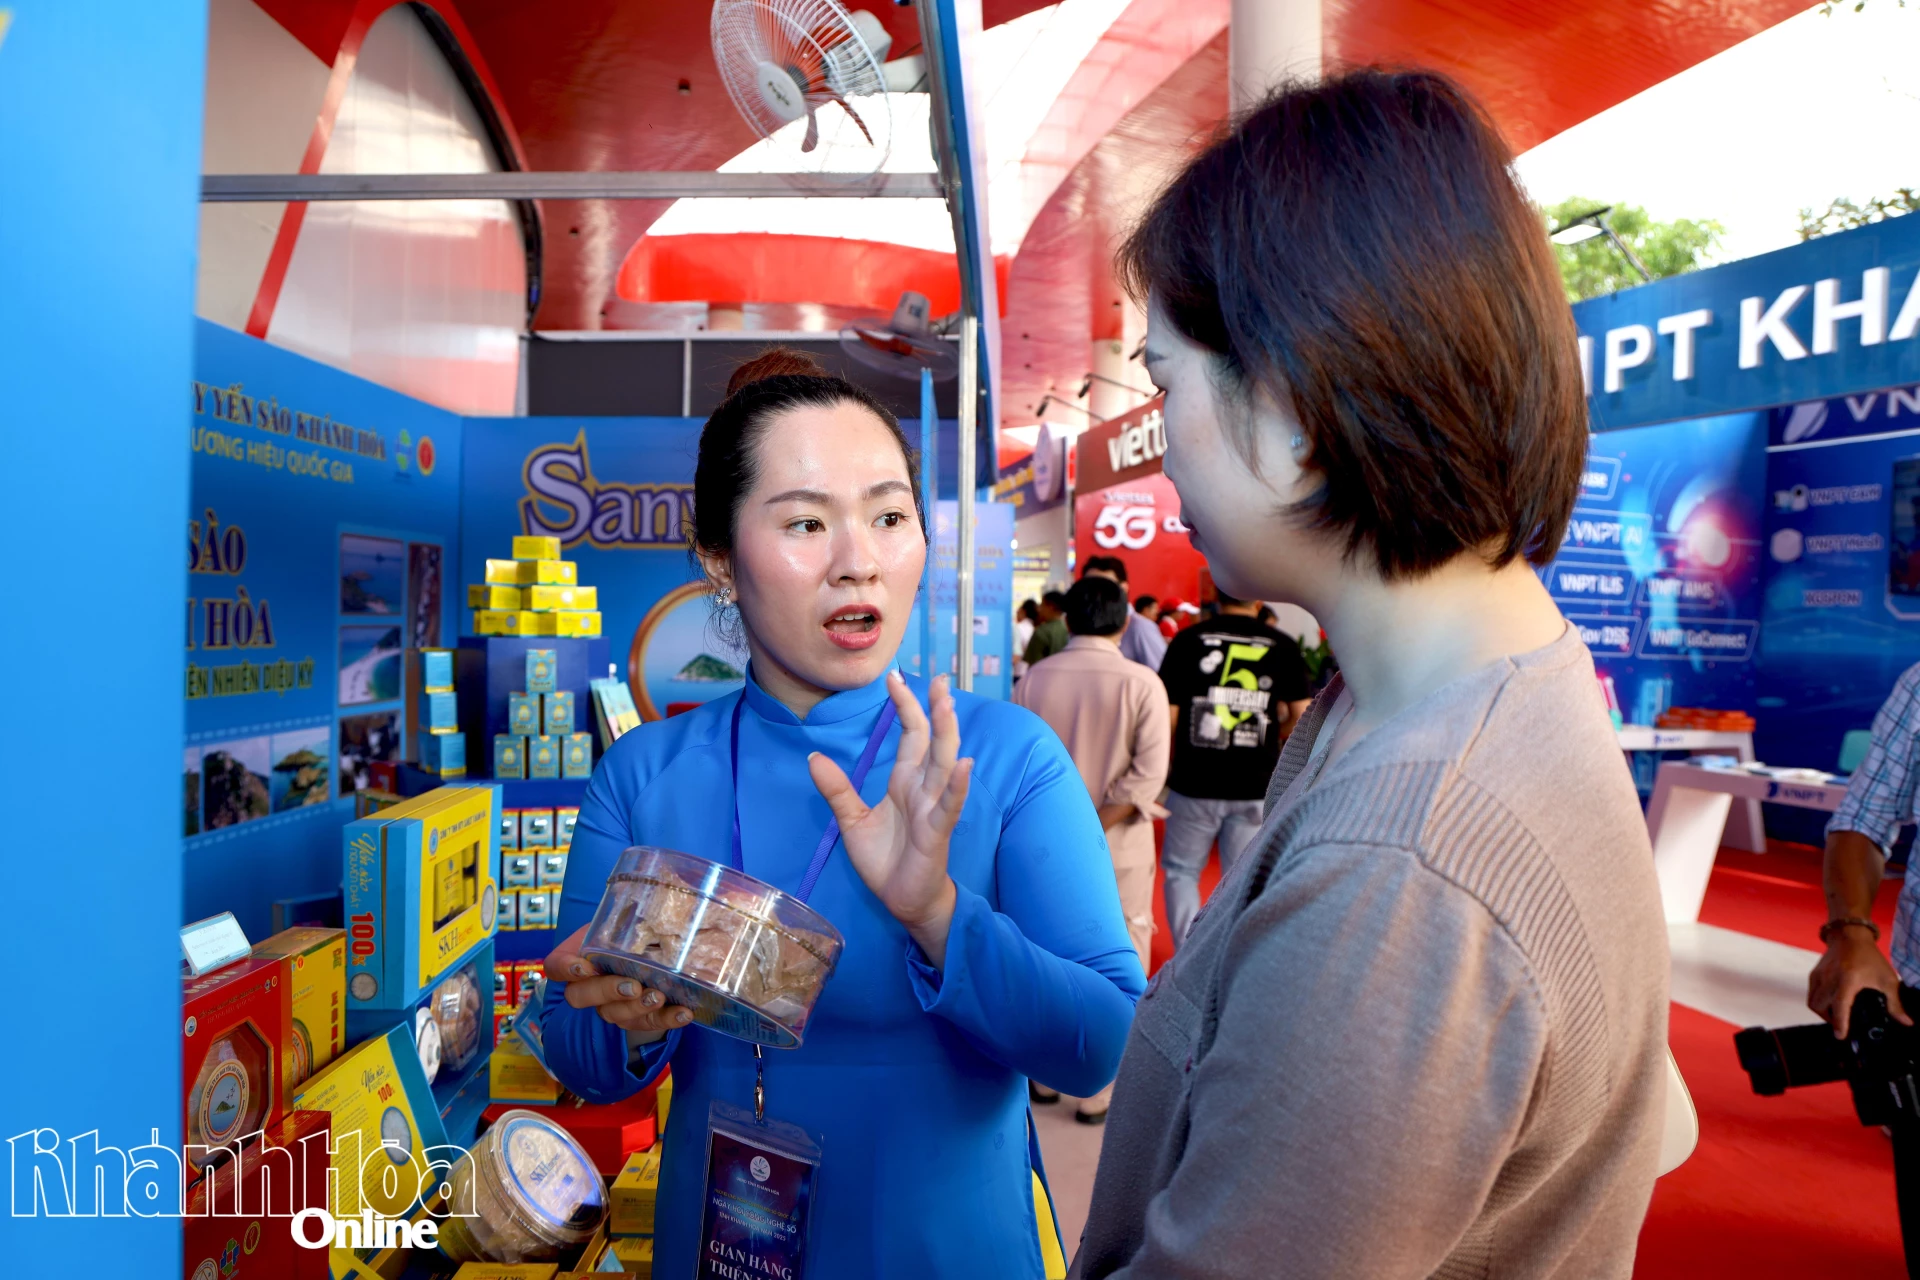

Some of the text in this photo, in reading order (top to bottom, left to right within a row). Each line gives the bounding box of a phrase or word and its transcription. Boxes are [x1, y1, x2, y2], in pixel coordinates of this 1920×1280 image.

[212, 382, 254, 427] YẾN
[257, 395, 292, 437] SÀO
[295, 411, 354, 453] KHÁNH
[357, 428, 387, 461] HÒA
[1108, 409, 1168, 472] viett
[247, 440, 285, 474] HIỆU
[287, 450, 328, 480] QUỐC
[330, 461, 354, 484] GIA
[1093, 504, 1157, 550] 5G
[1571, 520, 1623, 544] VNPT
[1559, 573, 1597, 593] VNPT
[203, 586, 275, 649] HÒA
[212, 659, 261, 698] NHIÊN
[263, 656, 295, 697] DIỆU
[351, 911, 376, 967] 100%
[709, 1239, 793, 1280] GIAN HÀNG
